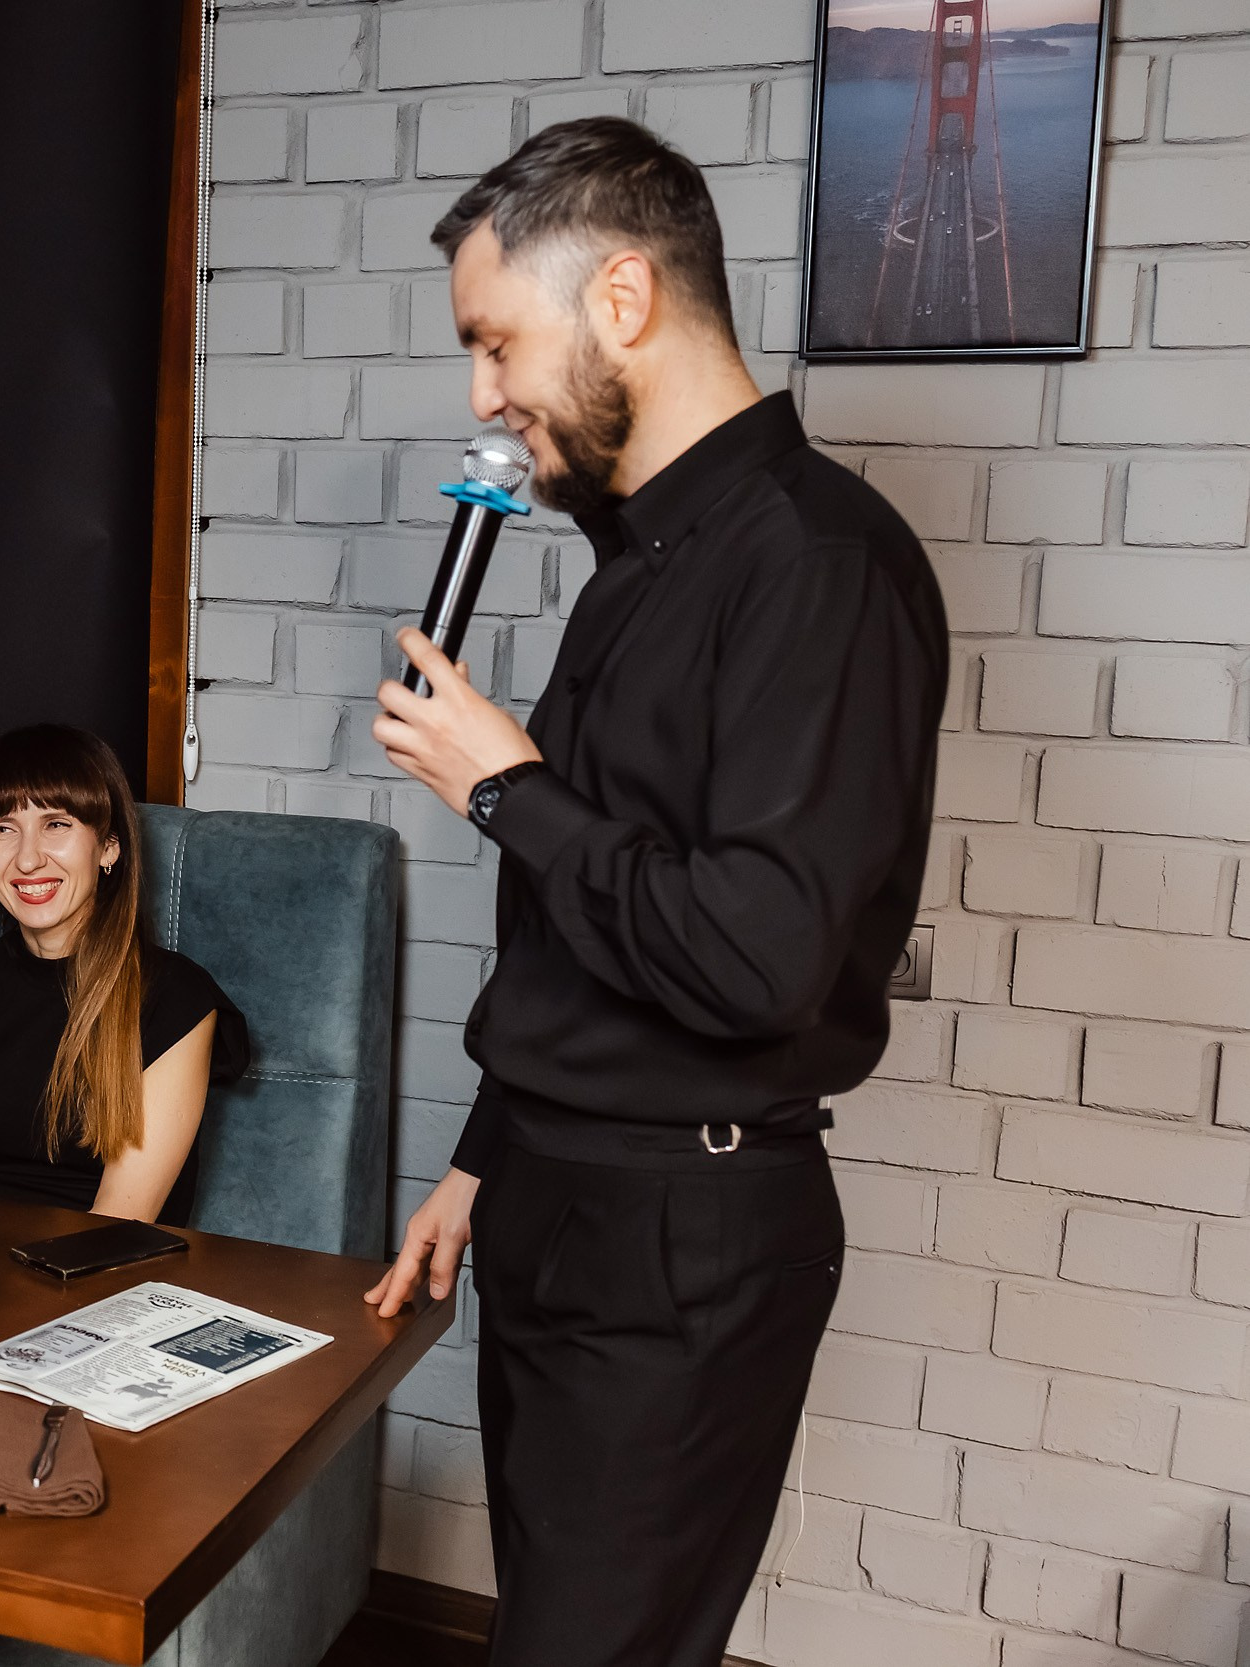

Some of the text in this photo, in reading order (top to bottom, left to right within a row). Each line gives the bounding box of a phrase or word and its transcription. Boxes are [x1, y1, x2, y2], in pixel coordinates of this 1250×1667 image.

[53, 1324, 111, 1343] ГАРНИРЫ
[161, 1363, 196, 1378] МЕНЮ
[163, 1358, 206, 1377] МАНГАЛ
